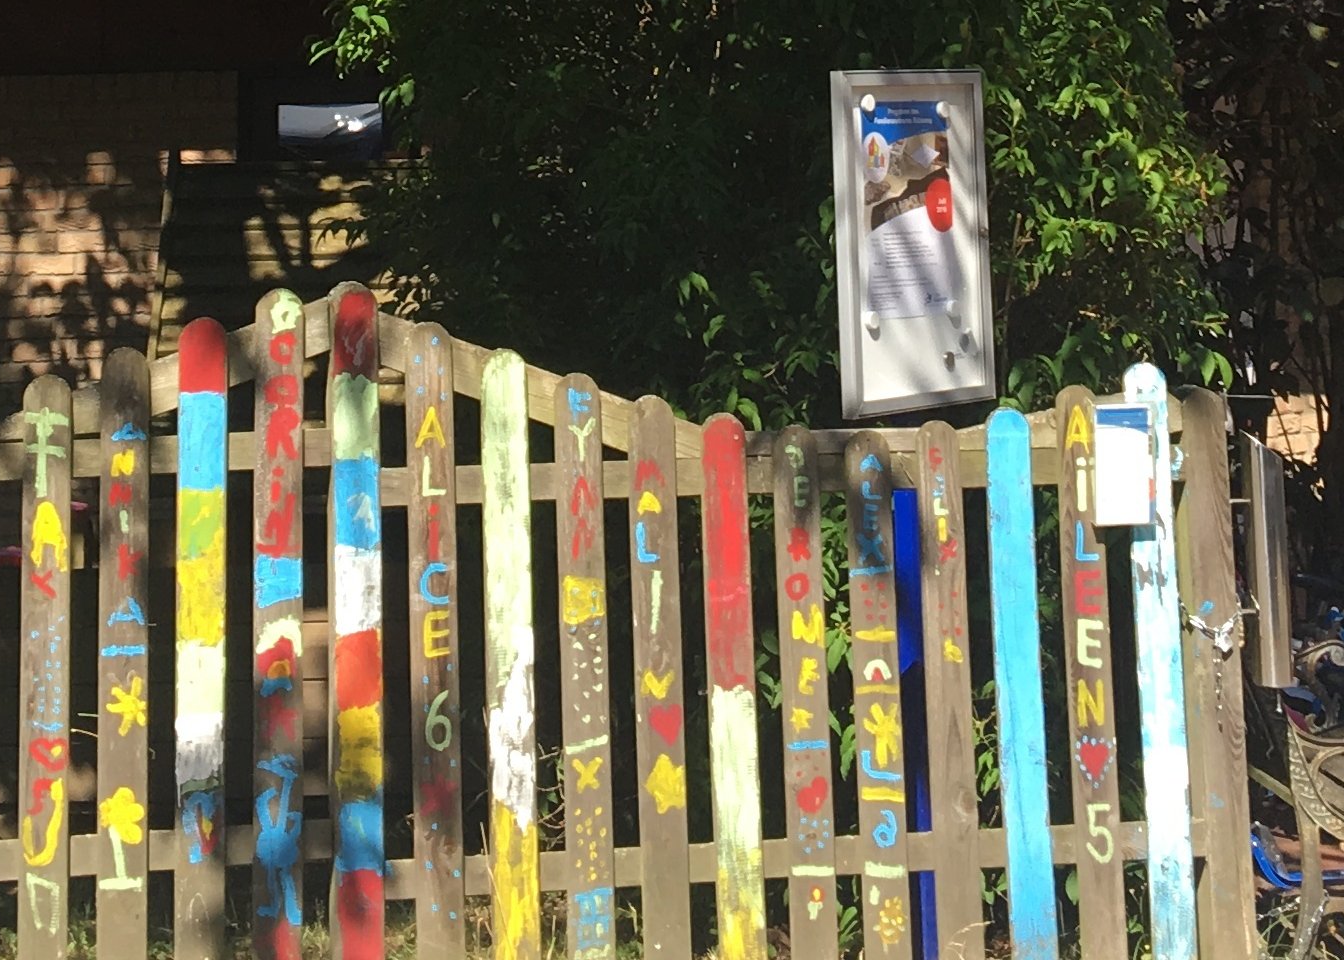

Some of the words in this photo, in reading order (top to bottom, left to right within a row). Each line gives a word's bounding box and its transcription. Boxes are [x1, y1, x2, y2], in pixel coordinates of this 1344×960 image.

[108, 422, 147, 627] ANNIKA
[425, 690, 452, 751] 6
[1085, 803, 1113, 864] 5
